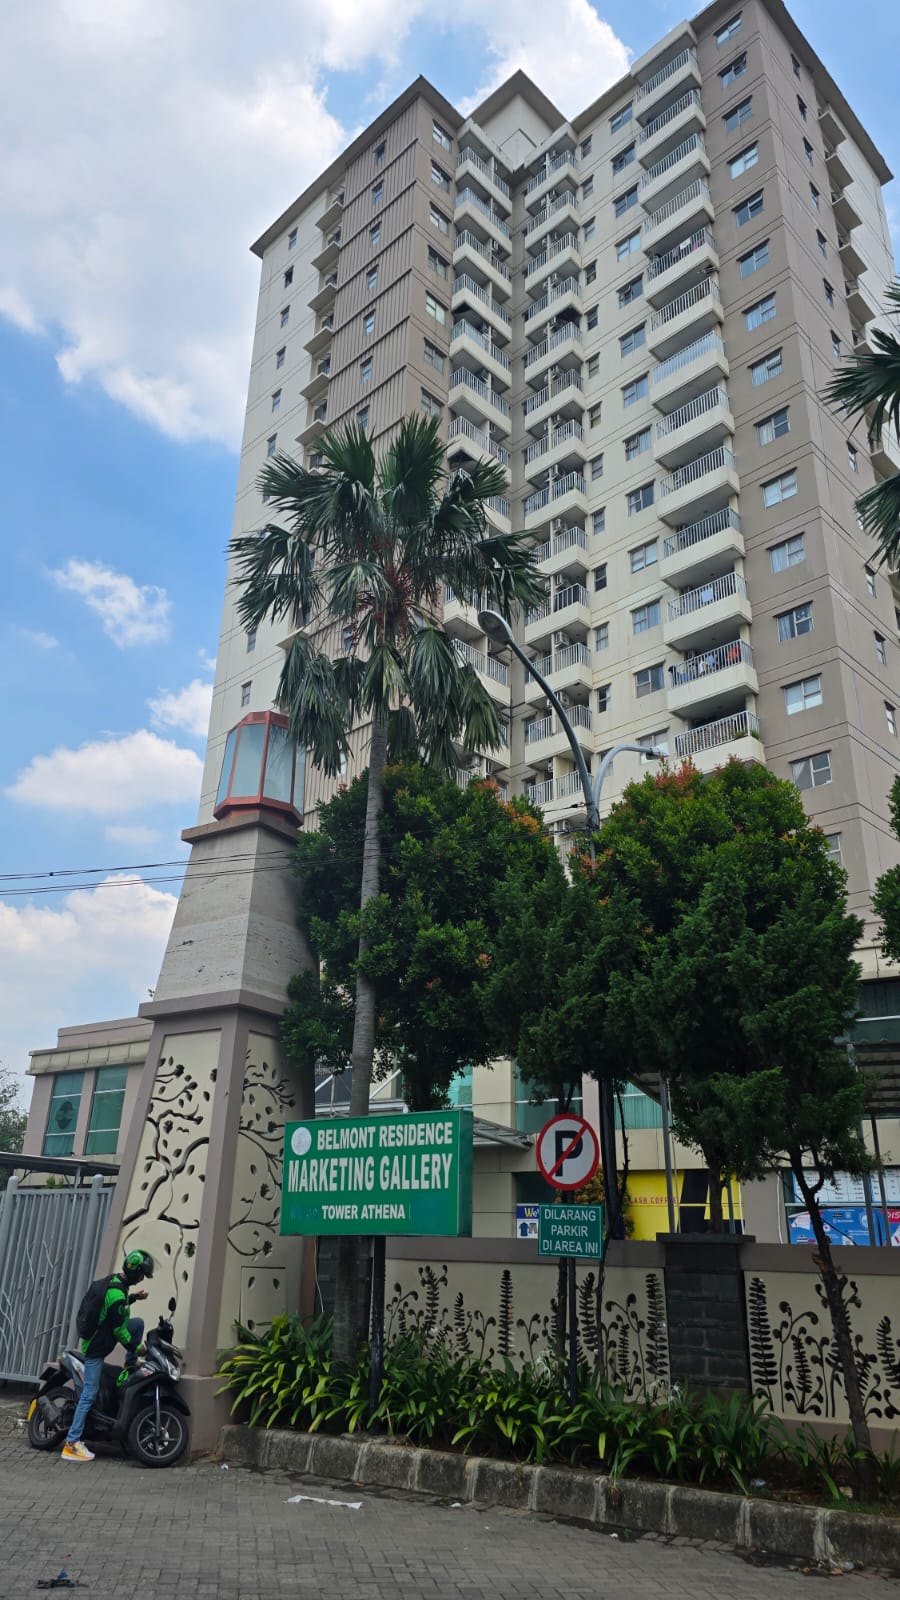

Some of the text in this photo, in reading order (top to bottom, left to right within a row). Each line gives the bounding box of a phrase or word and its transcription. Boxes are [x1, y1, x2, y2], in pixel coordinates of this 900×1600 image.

[317, 1122, 453, 1151] BELMONT RESIDENCE
[288, 1153, 453, 1192] MARKETING GALLERY
[321, 1205, 358, 1219] TOWER
[361, 1204, 406, 1219] ATHENA
[544, 1208, 597, 1222] DILARANG
[551, 1225, 588, 1237] PARKIR
[542, 1240, 599, 1254] DI AREA INI
